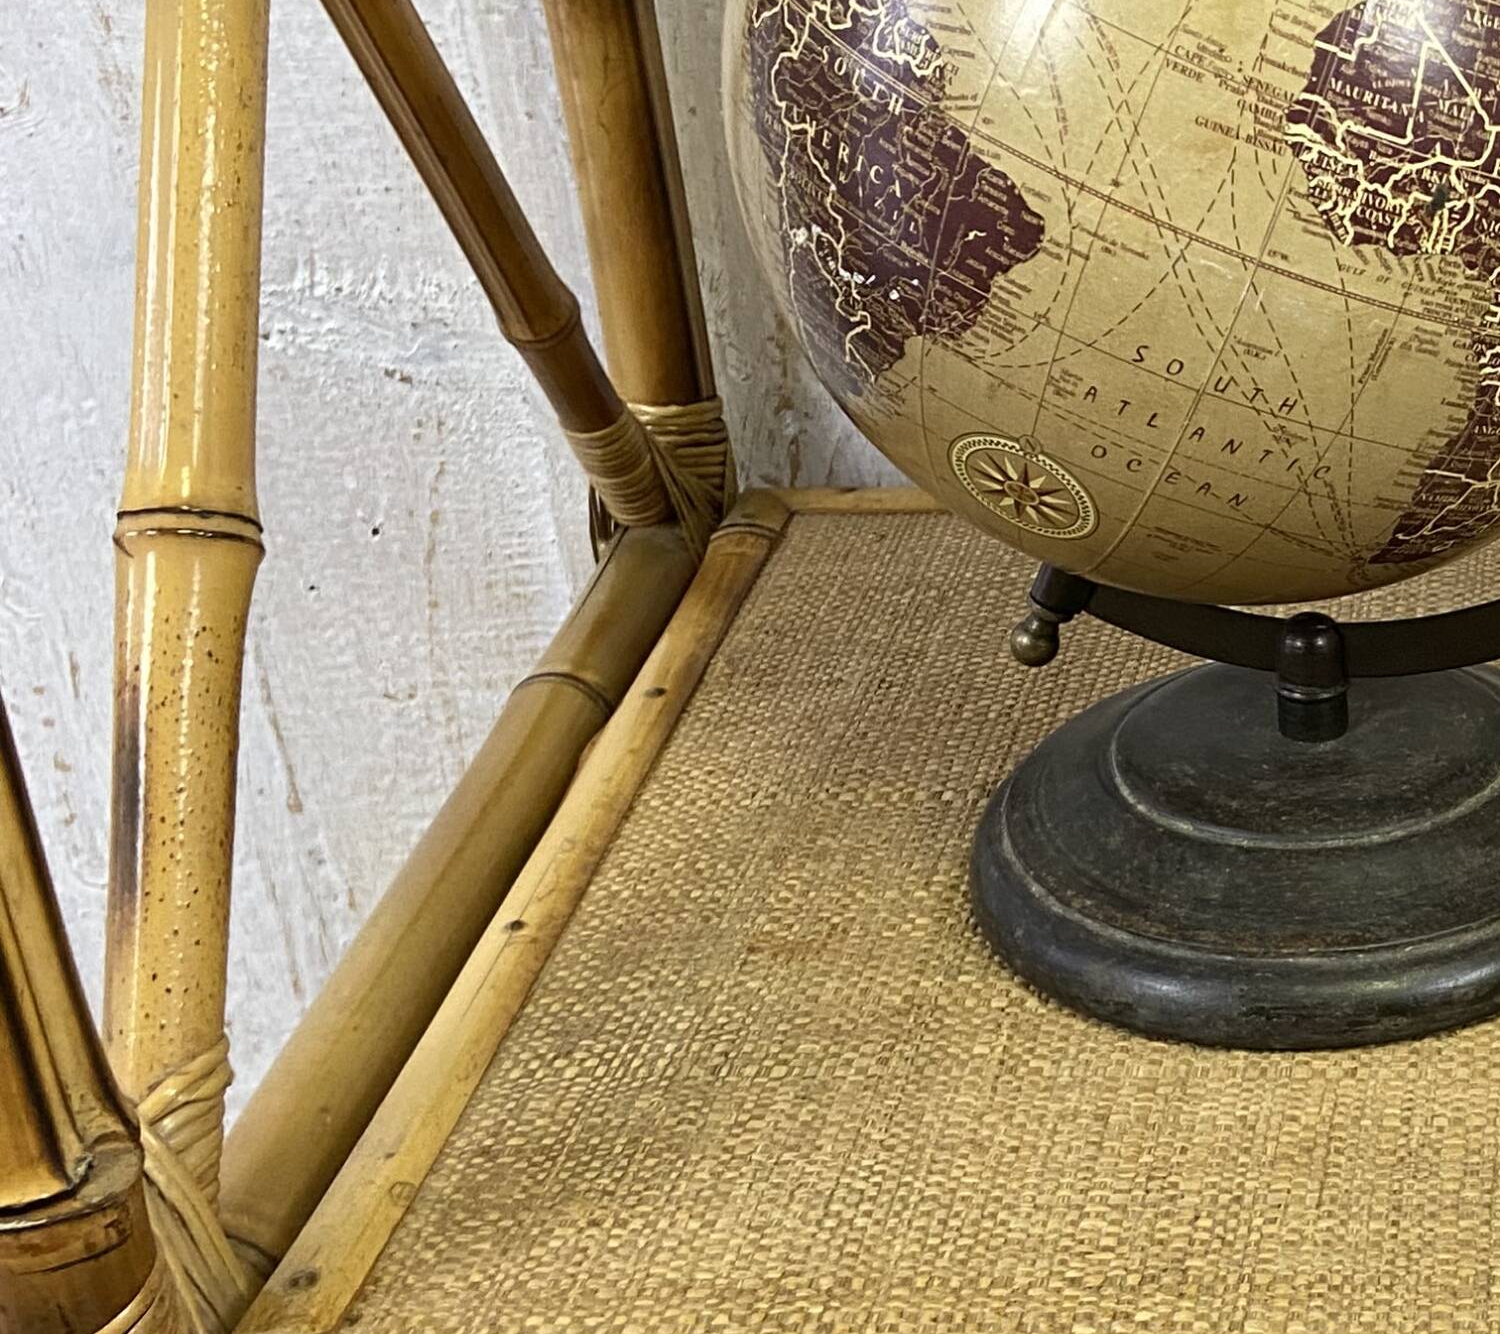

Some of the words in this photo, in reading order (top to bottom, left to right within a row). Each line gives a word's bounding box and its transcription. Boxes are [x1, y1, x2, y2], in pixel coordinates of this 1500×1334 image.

[1165, 58, 1207, 83] VERDE
[1174, 44, 1207, 66] CAPE
[822, 45, 904, 116] SOUTH
[1242, 73, 1295, 103] SENEGAL
[1329, 77, 1425, 124] MAURITANIA
[1362, 192, 1401, 215] IVORY
[1131, 345, 1298, 415] SOUTH
[1083, 385, 1331, 480] ATLANTIC
[1090, 444, 1248, 508] OCEAN
